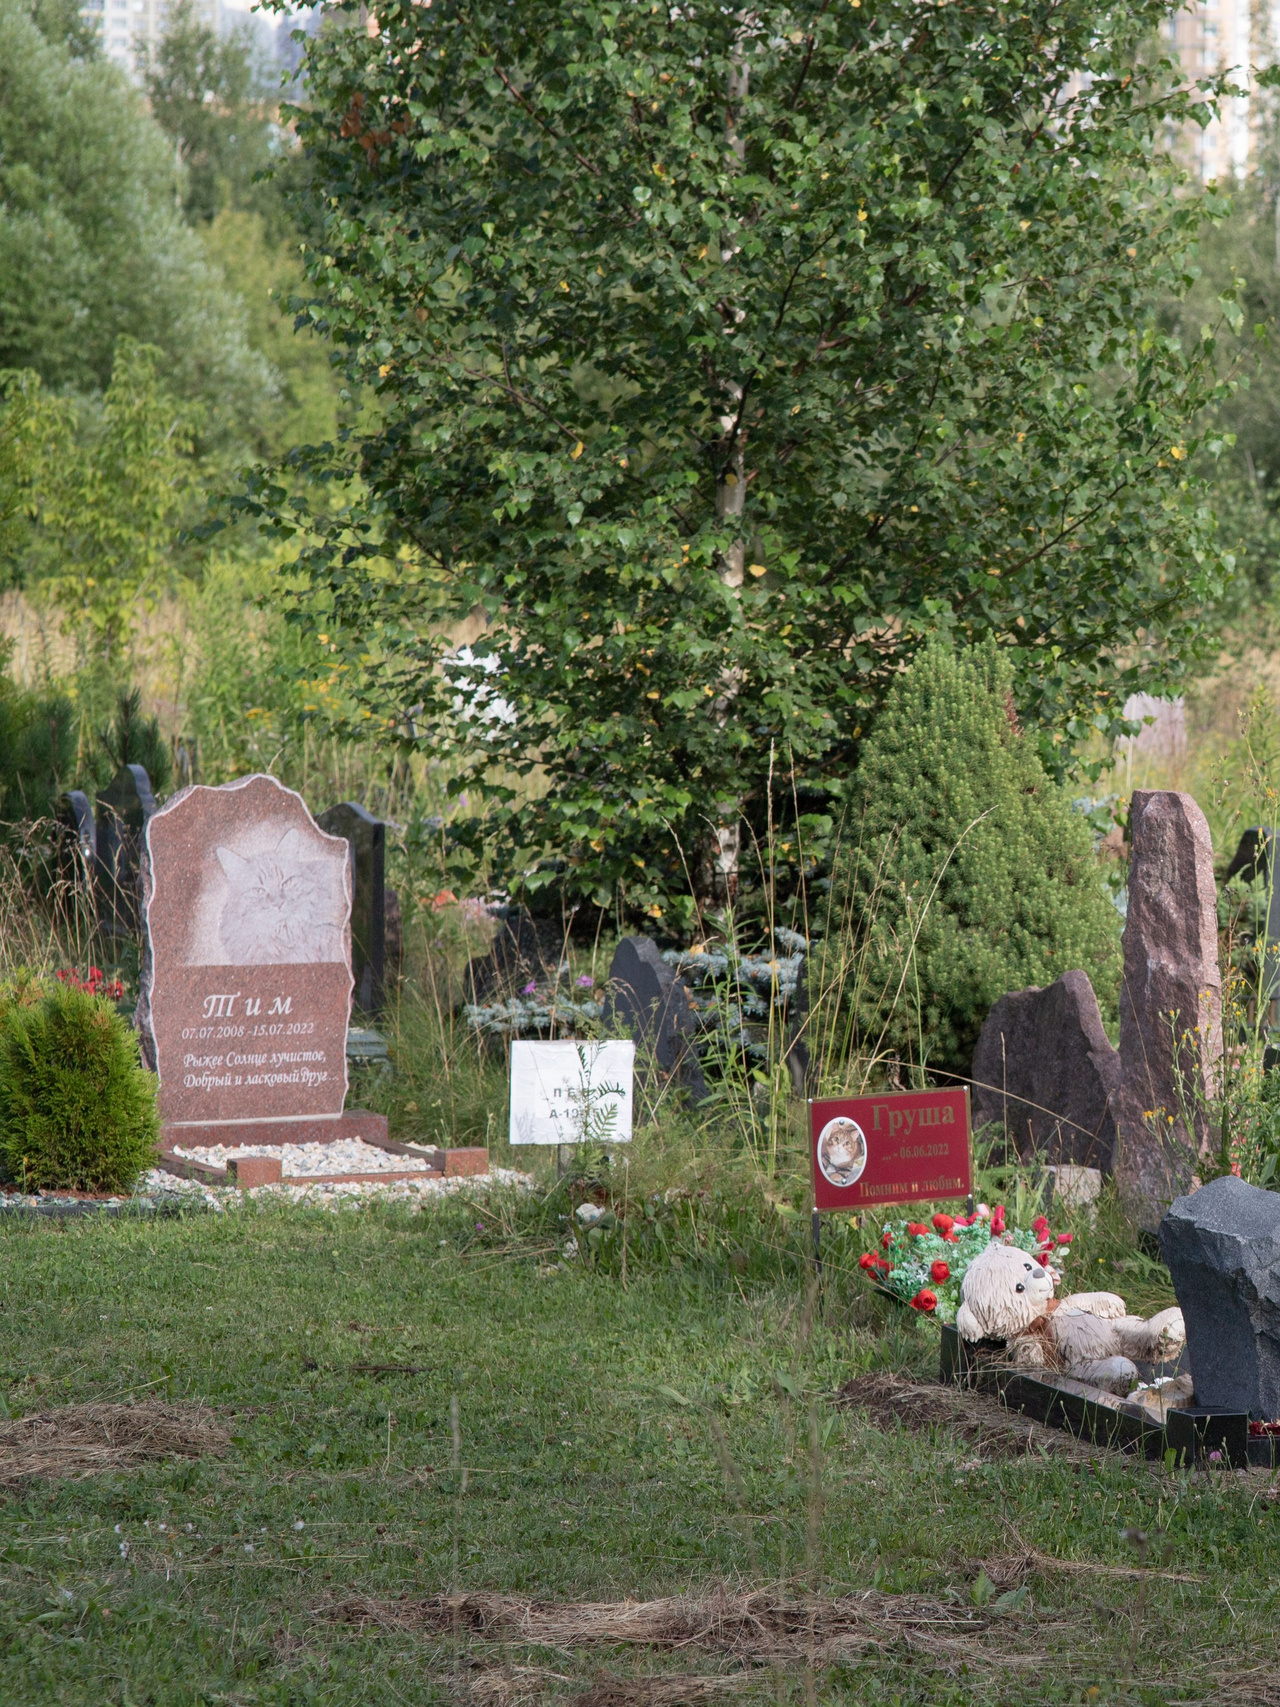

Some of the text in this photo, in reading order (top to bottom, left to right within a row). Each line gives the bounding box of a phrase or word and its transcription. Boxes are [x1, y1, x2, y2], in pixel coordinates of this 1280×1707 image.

[181, 1026, 245, 1040] 07.07.2008
[183, 1050, 326, 1070] Рыжее Солнце лучистое,
[183, 1071, 232, 1092] Добрый
[234, 1074, 243, 1086] и
[244, 1069, 300, 1088] ласковый
[871, 1105, 955, 1136] Груша
[900, 1143, 949, 1159] 06.06.2022
[860, 1175, 965, 1198] Помним и любим.
